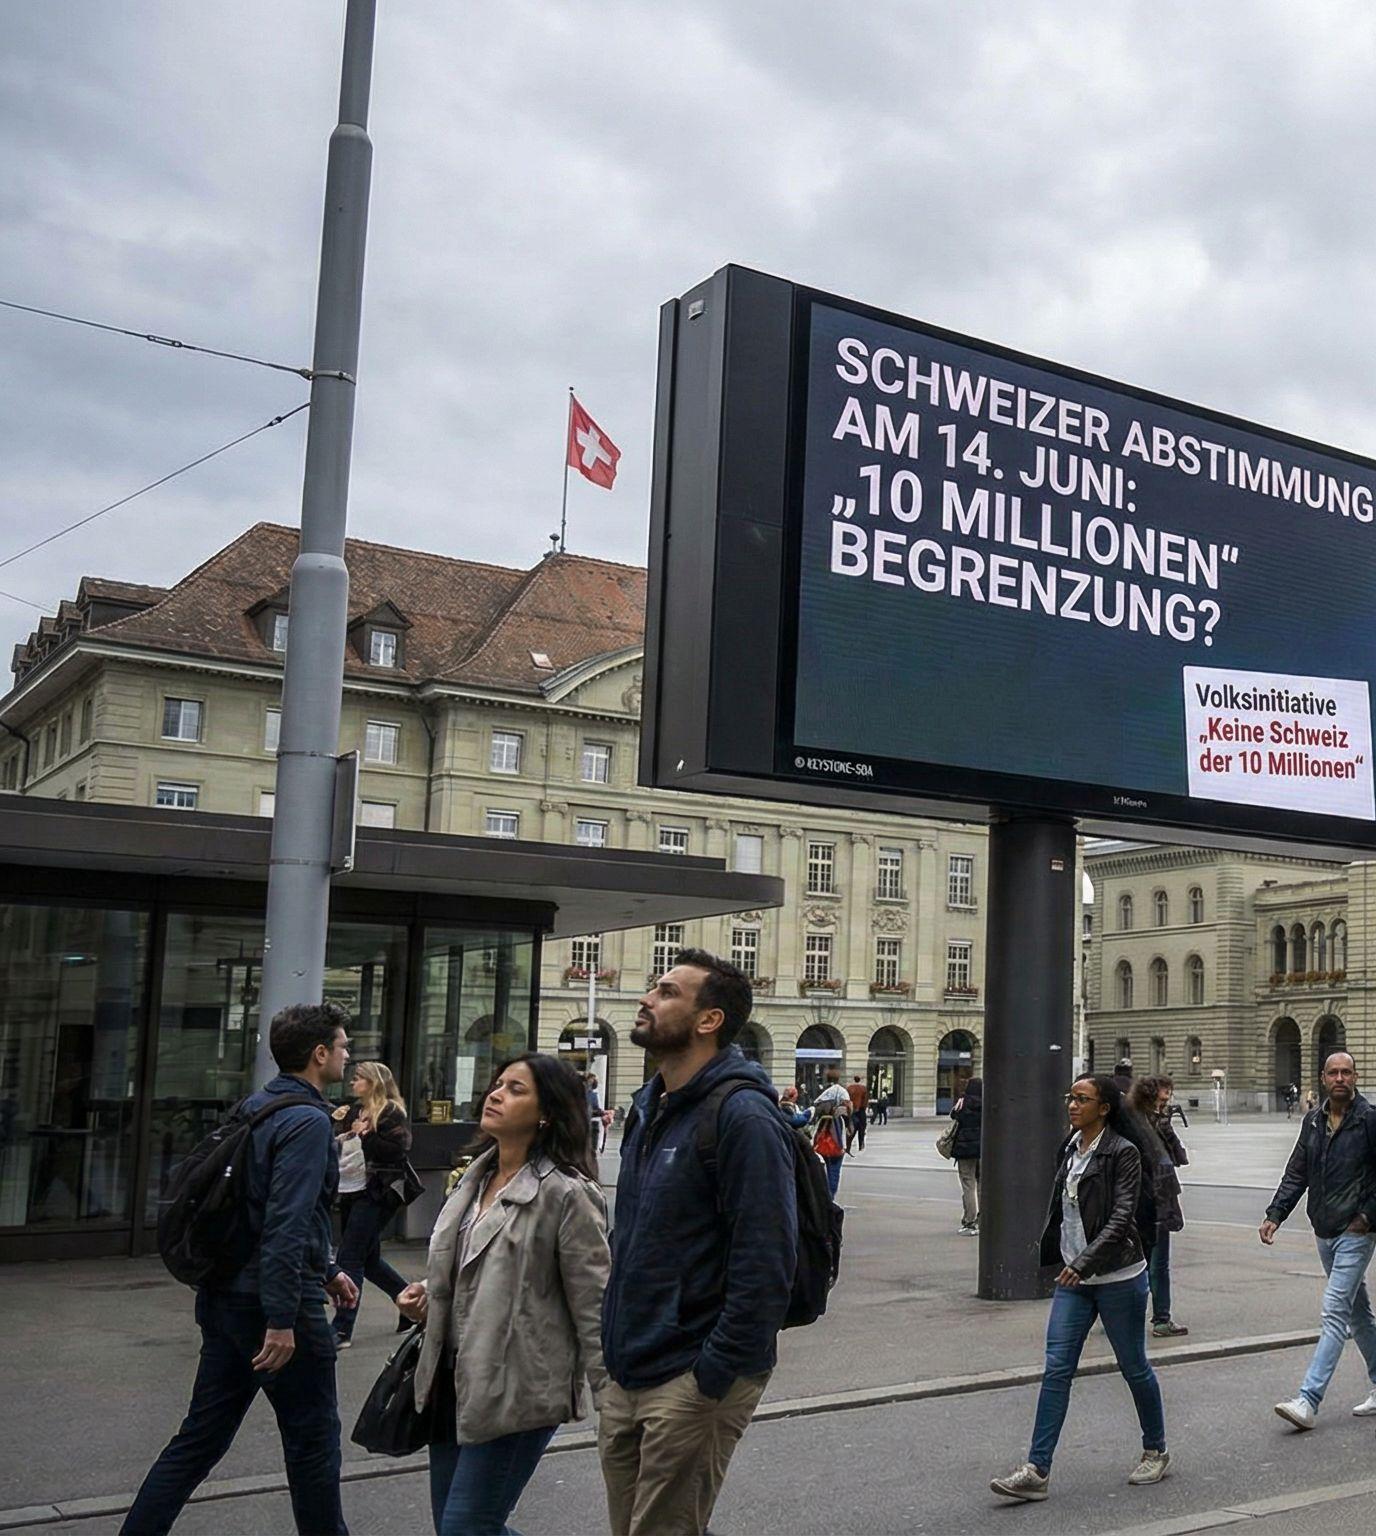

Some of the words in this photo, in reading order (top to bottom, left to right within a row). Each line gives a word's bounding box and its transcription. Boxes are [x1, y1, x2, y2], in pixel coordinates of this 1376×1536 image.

[832, 396, 920, 460] AM
[937, 423, 1004, 480] 14.
[1018, 445, 1137, 513] JUNI:
[835, 337, 1111, 453] SCHWEIZER
[1121, 420, 1375, 523] ABSTIMMUNG
[830, 520, 1221, 647] BEGRENZUNG?
[831, 464, 923, 523] „10
[941, 479, 1239, 590] MILLIONEN“
[1195, 683, 1337, 717] Volksinitiative
[1199, 716, 1265, 745] „Keine
[1269, 720, 1349, 749] Schweiz
[1199, 747, 1233, 773] der
[1238, 750, 1262, 775] 10
[1268, 751, 1364, 779] Millionen“
